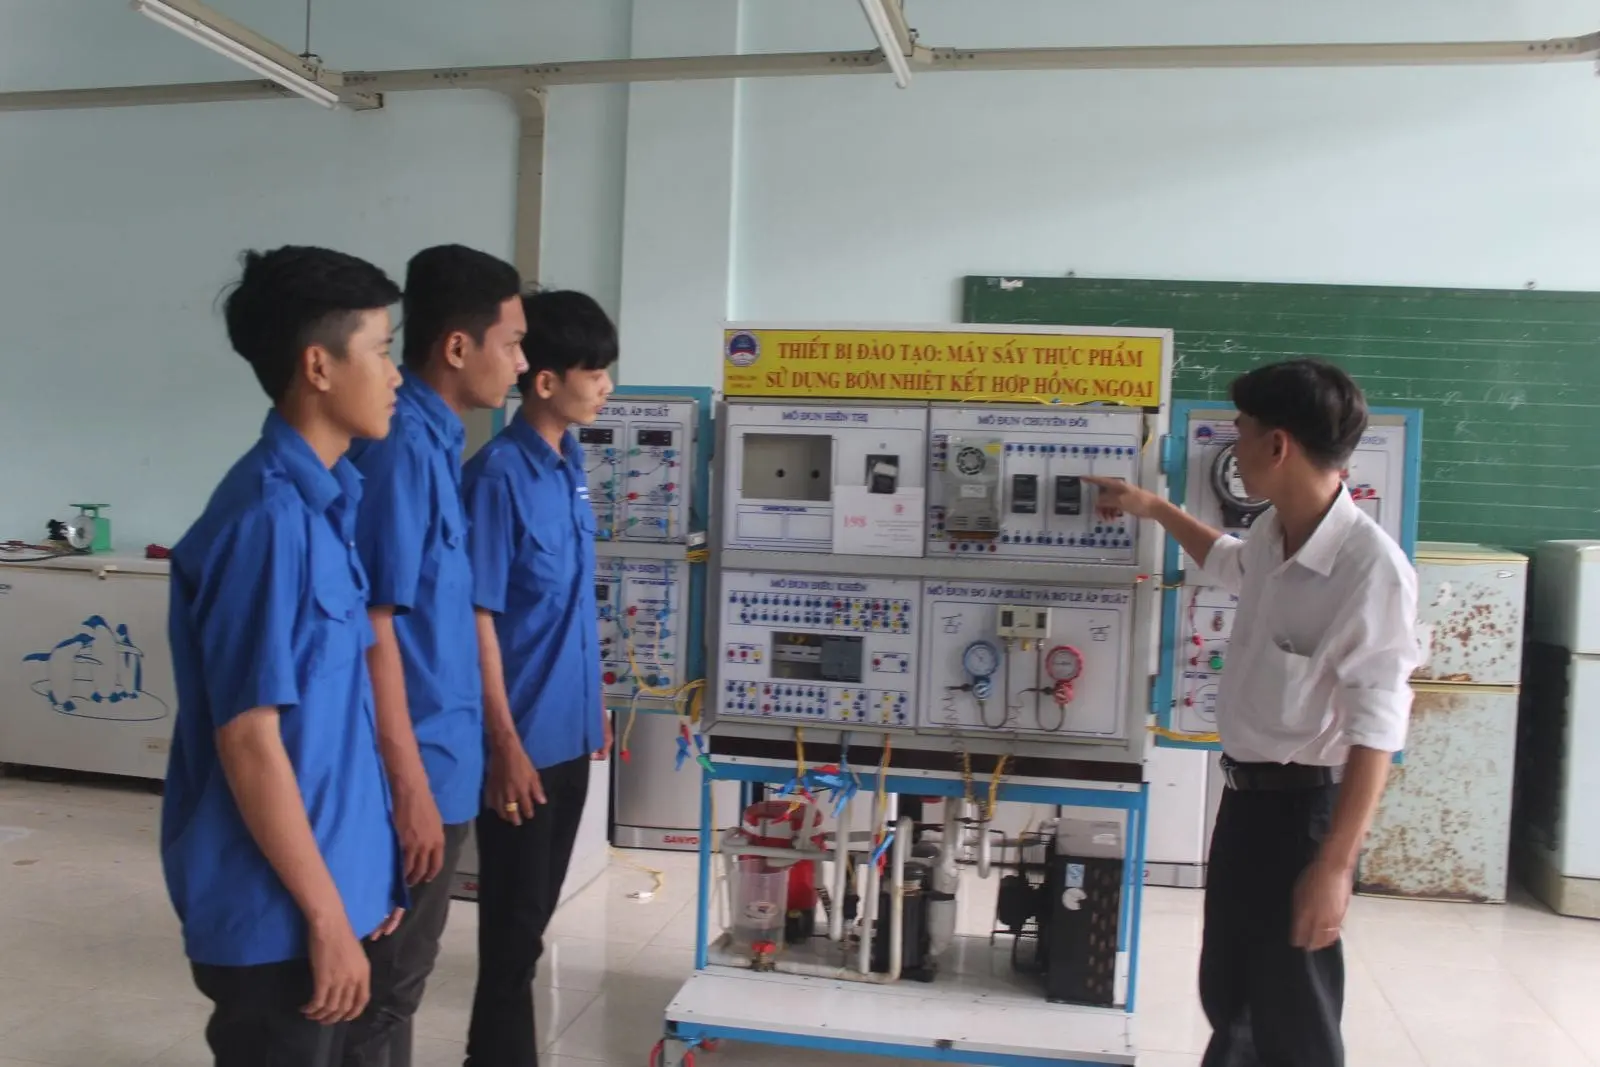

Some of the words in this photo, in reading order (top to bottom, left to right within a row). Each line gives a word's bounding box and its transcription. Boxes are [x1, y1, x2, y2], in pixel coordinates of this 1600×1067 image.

[778, 335, 829, 360] THIẾT
[835, 343, 852, 364] BỊ
[857, 339, 895, 360] ĐÀO
[900, 344, 942, 365] TẠO:
[947, 340, 988, 363] MÁY
[992, 339, 1029, 364] SẤY
[1033, 345, 1084, 369] THỰC
[1088, 340, 1143, 367] PHẨM
[766, 366, 788, 388] SỬ
[792, 372, 840, 392] DỤNG
[846, 370, 886, 390] BƠM
[890, 369, 946, 394] NHIỆT
[950, 368, 987, 392] KẾT
[991, 374, 1029, 395] HỢP
[1092, 378, 1154, 402] NGOẠI
